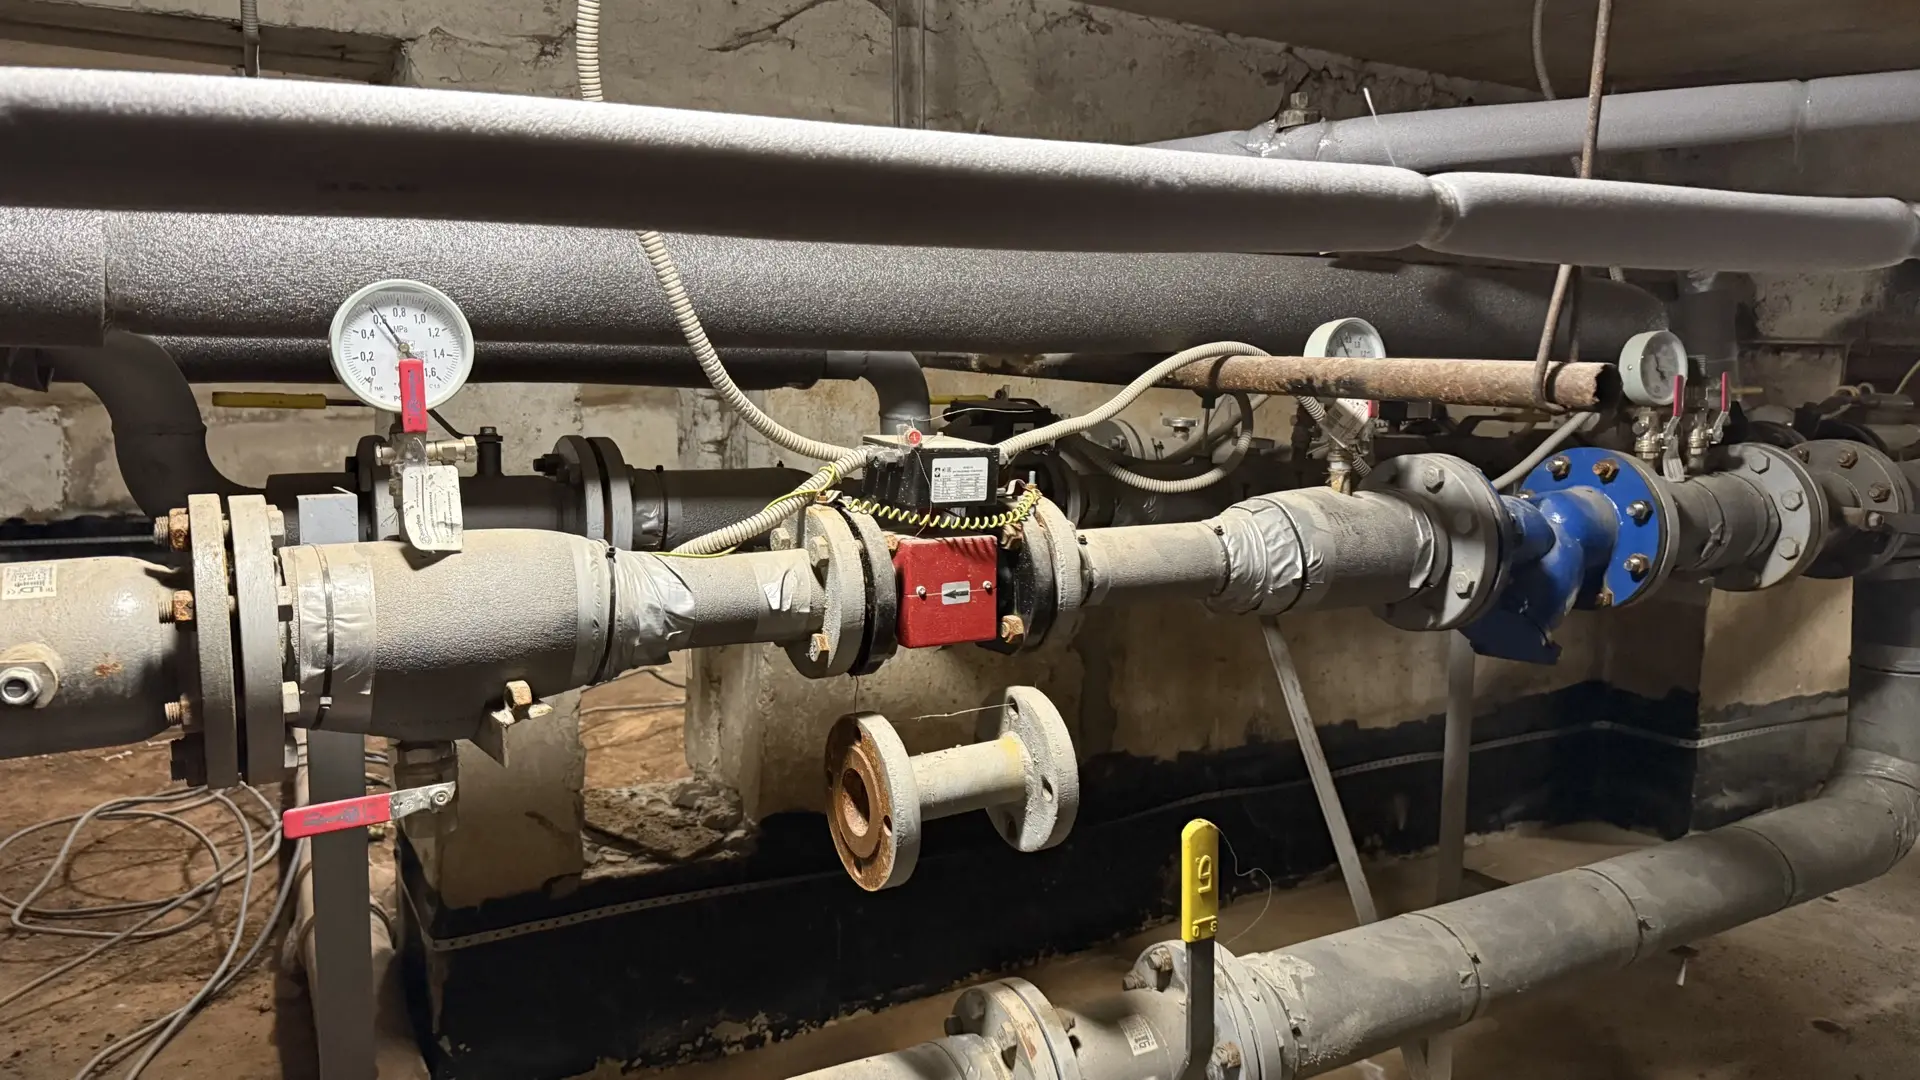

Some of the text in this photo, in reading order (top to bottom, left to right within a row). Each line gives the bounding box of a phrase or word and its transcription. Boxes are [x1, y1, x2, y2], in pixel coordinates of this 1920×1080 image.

[393, 307, 406, 318] 0,8
[414, 314, 426, 324] 1,0
[361, 329, 375, 339] 0,4
[393, 325, 408, 333] MPa
[428, 327, 440, 338] 1,2
[360, 351, 374, 362] 0,2
[433, 349, 445, 359] 1,4
[370, 366, 376, 377] 0
[424, 367, 437, 378] 1,6
